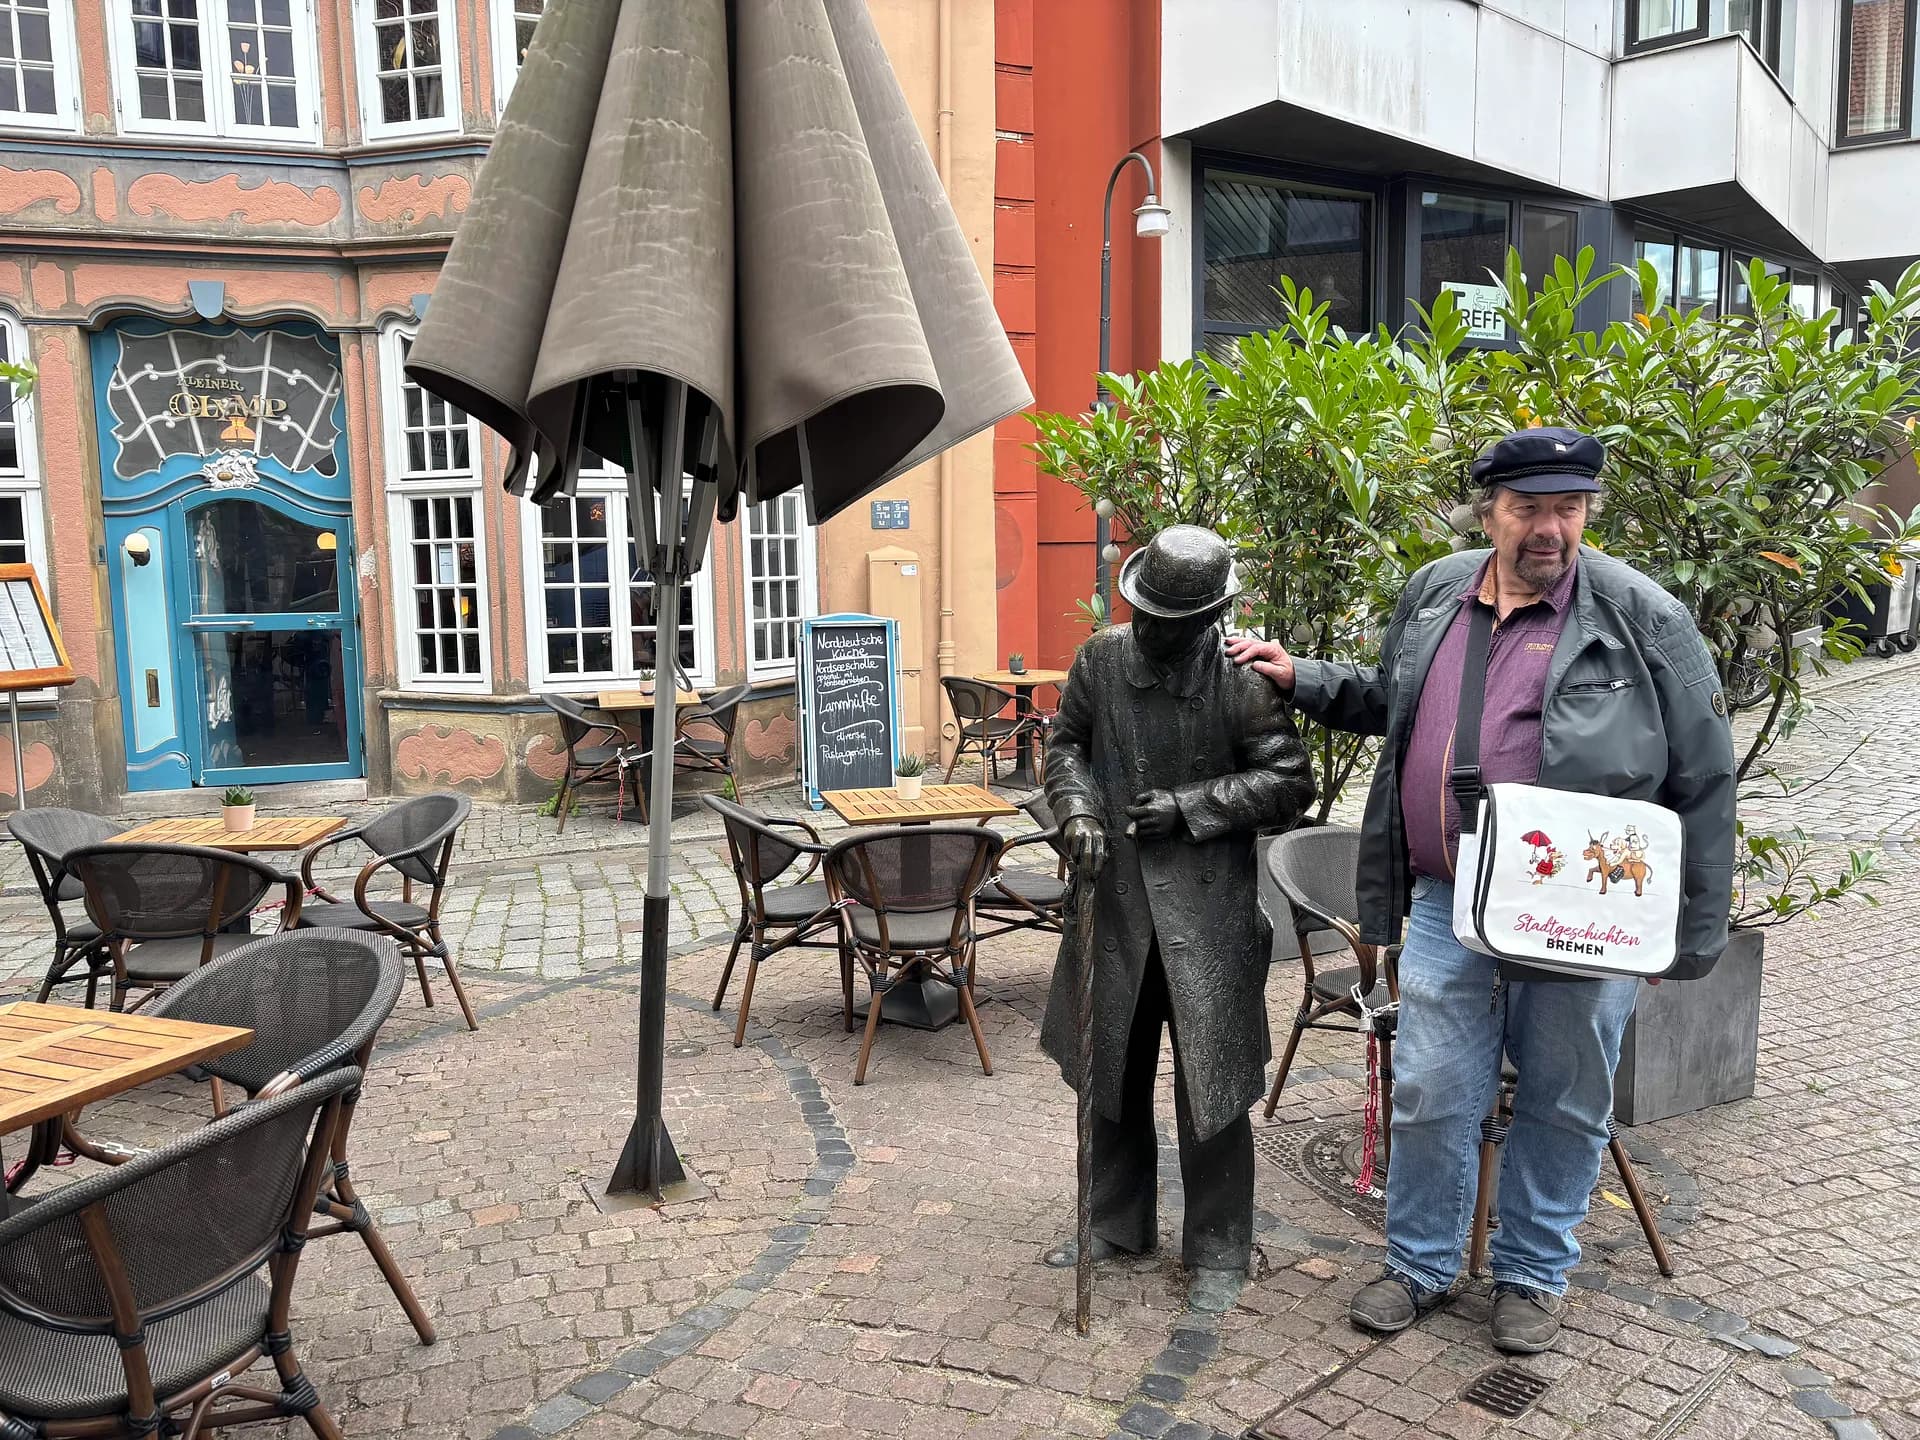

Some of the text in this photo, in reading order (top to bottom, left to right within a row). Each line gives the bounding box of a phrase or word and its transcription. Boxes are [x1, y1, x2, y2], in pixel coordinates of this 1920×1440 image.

[817, 632, 884, 650] Norddeutsche
[832, 647, 868, 660] Küche
[815, 658, 879, 675] Nordseescholle
[819, 689, 880, 715] Lammhüfte
[836, 730, 866, 741] diverse
[819, 738, 884, 765] Pastagerichte
[1513, 913, 1641, 946] Stadtgeschichten
[1546, 938, 1604, 956] BREMEN
